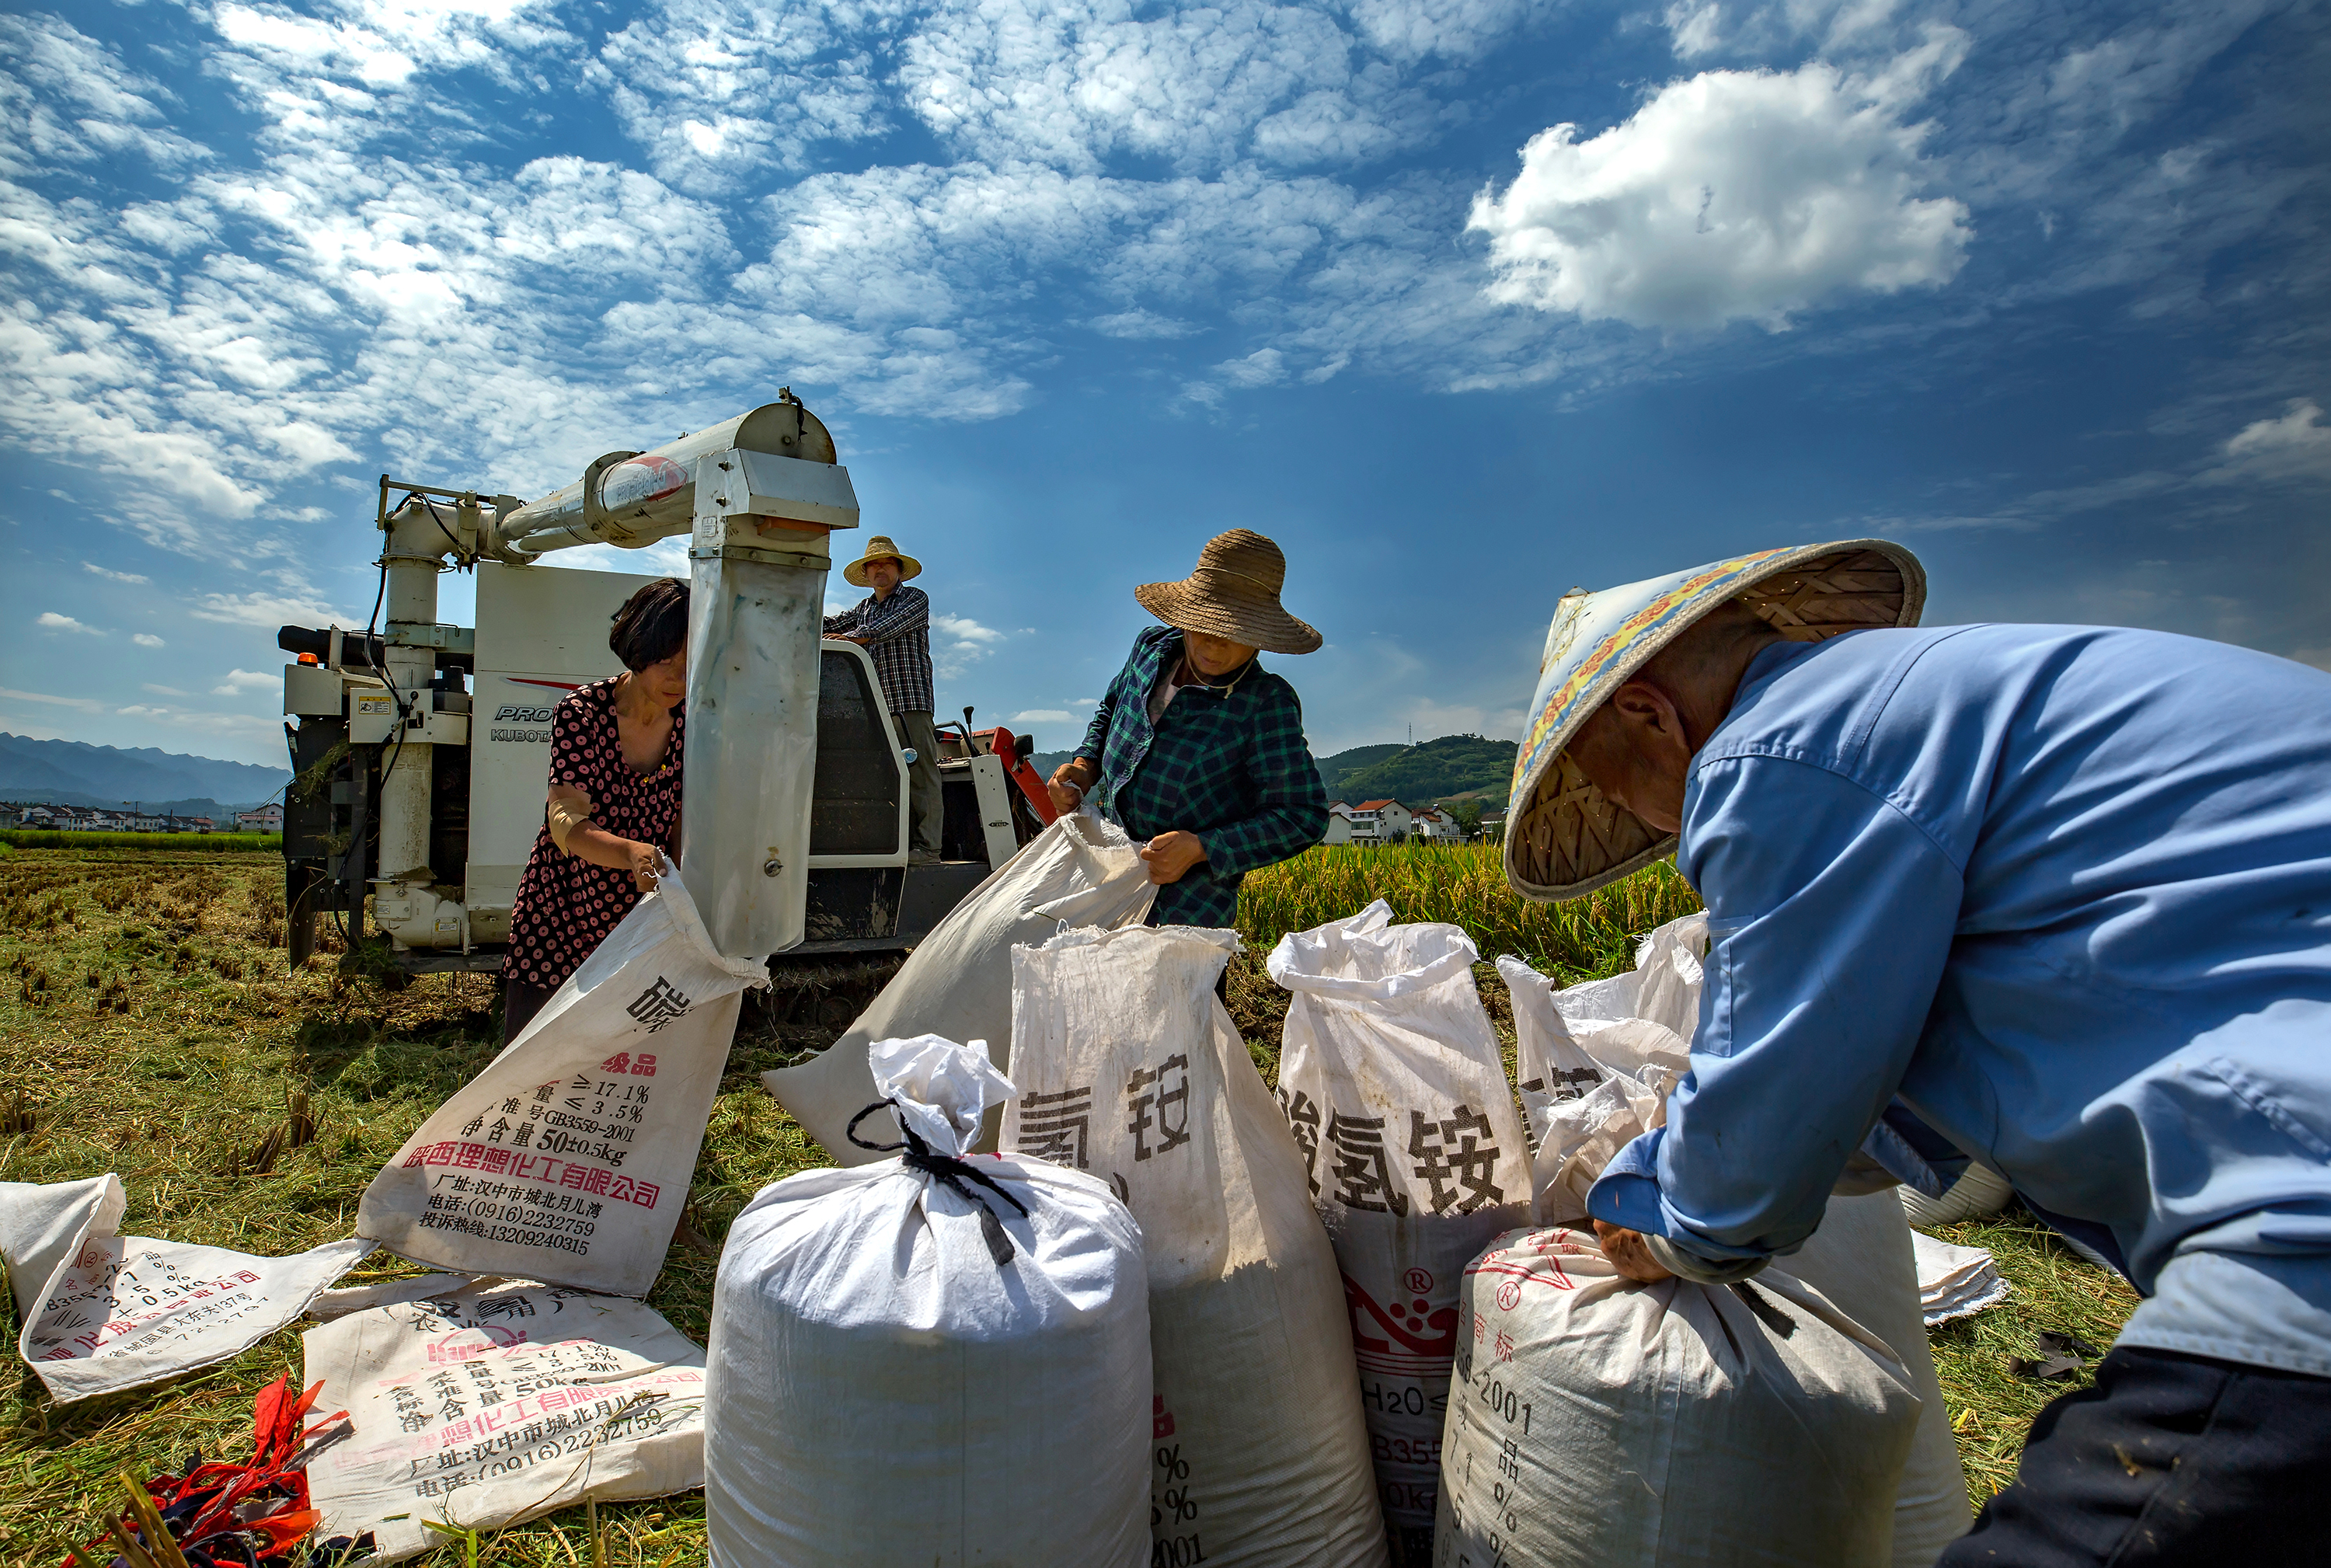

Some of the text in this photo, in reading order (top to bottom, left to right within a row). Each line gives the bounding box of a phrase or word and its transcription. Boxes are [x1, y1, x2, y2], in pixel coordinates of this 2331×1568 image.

[594, 1081, 650, 1104] 17.1%
[479, 1096, 636, 1143] 准号GB3559-2001
[402, 1141, 660, 1210] 陕西理想化工有限公司
